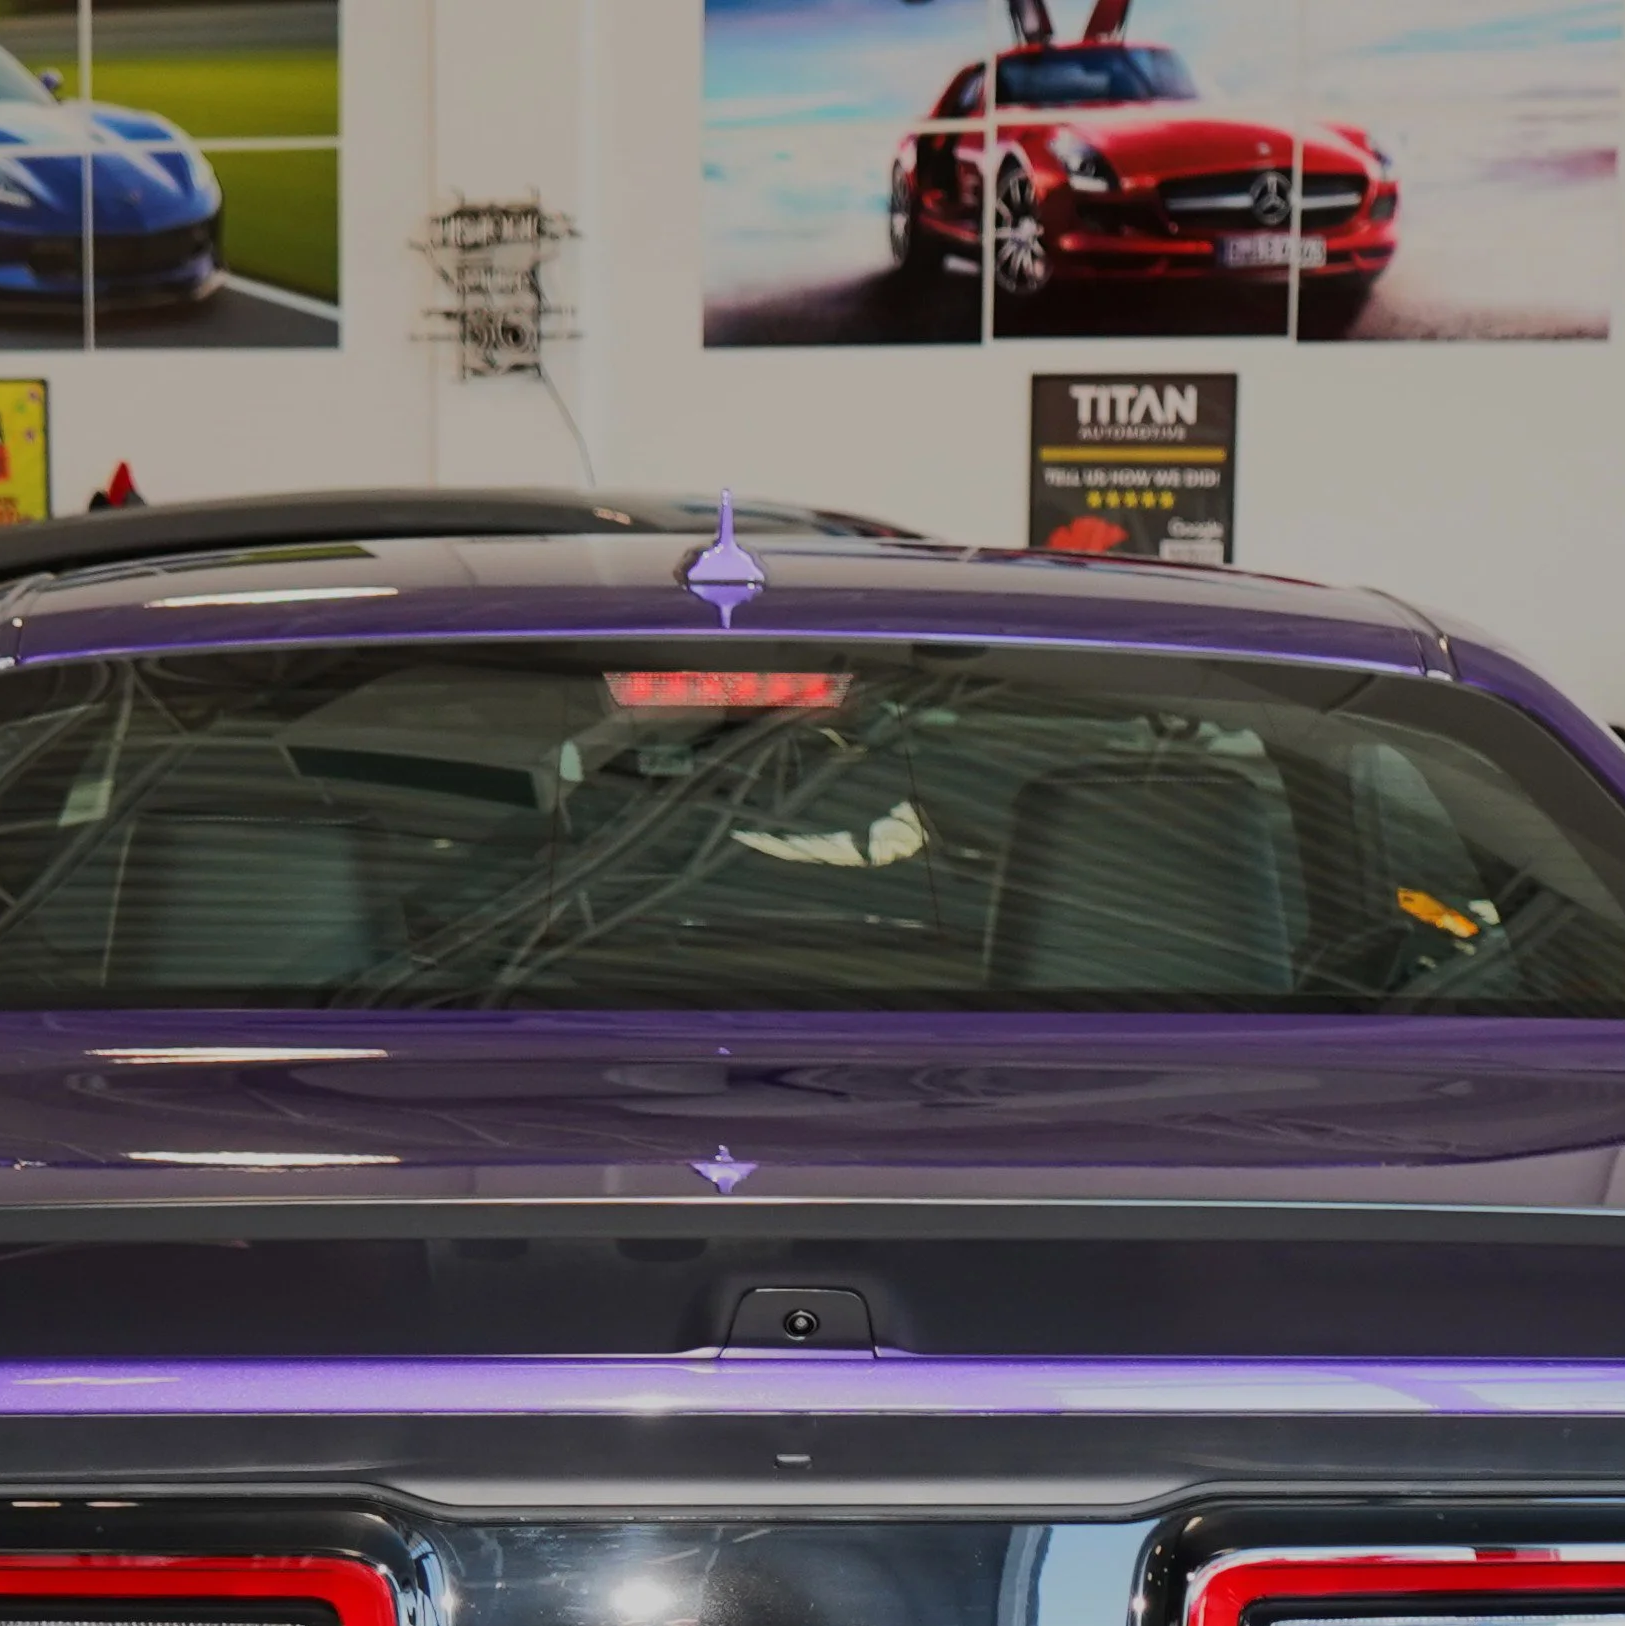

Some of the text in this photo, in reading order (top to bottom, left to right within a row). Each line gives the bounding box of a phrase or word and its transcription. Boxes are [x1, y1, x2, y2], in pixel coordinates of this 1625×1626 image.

[1070, 384, 1198, 424] TITAN
[1078, 424, 1187, 441] AUTOMOTIVE
[1044, 467, 1081, 487] TELL
[1082, 467, 1107, 487] US
[1108, 467, 1151, 487] HOW
[1152, 468, 1181, 487] WE
